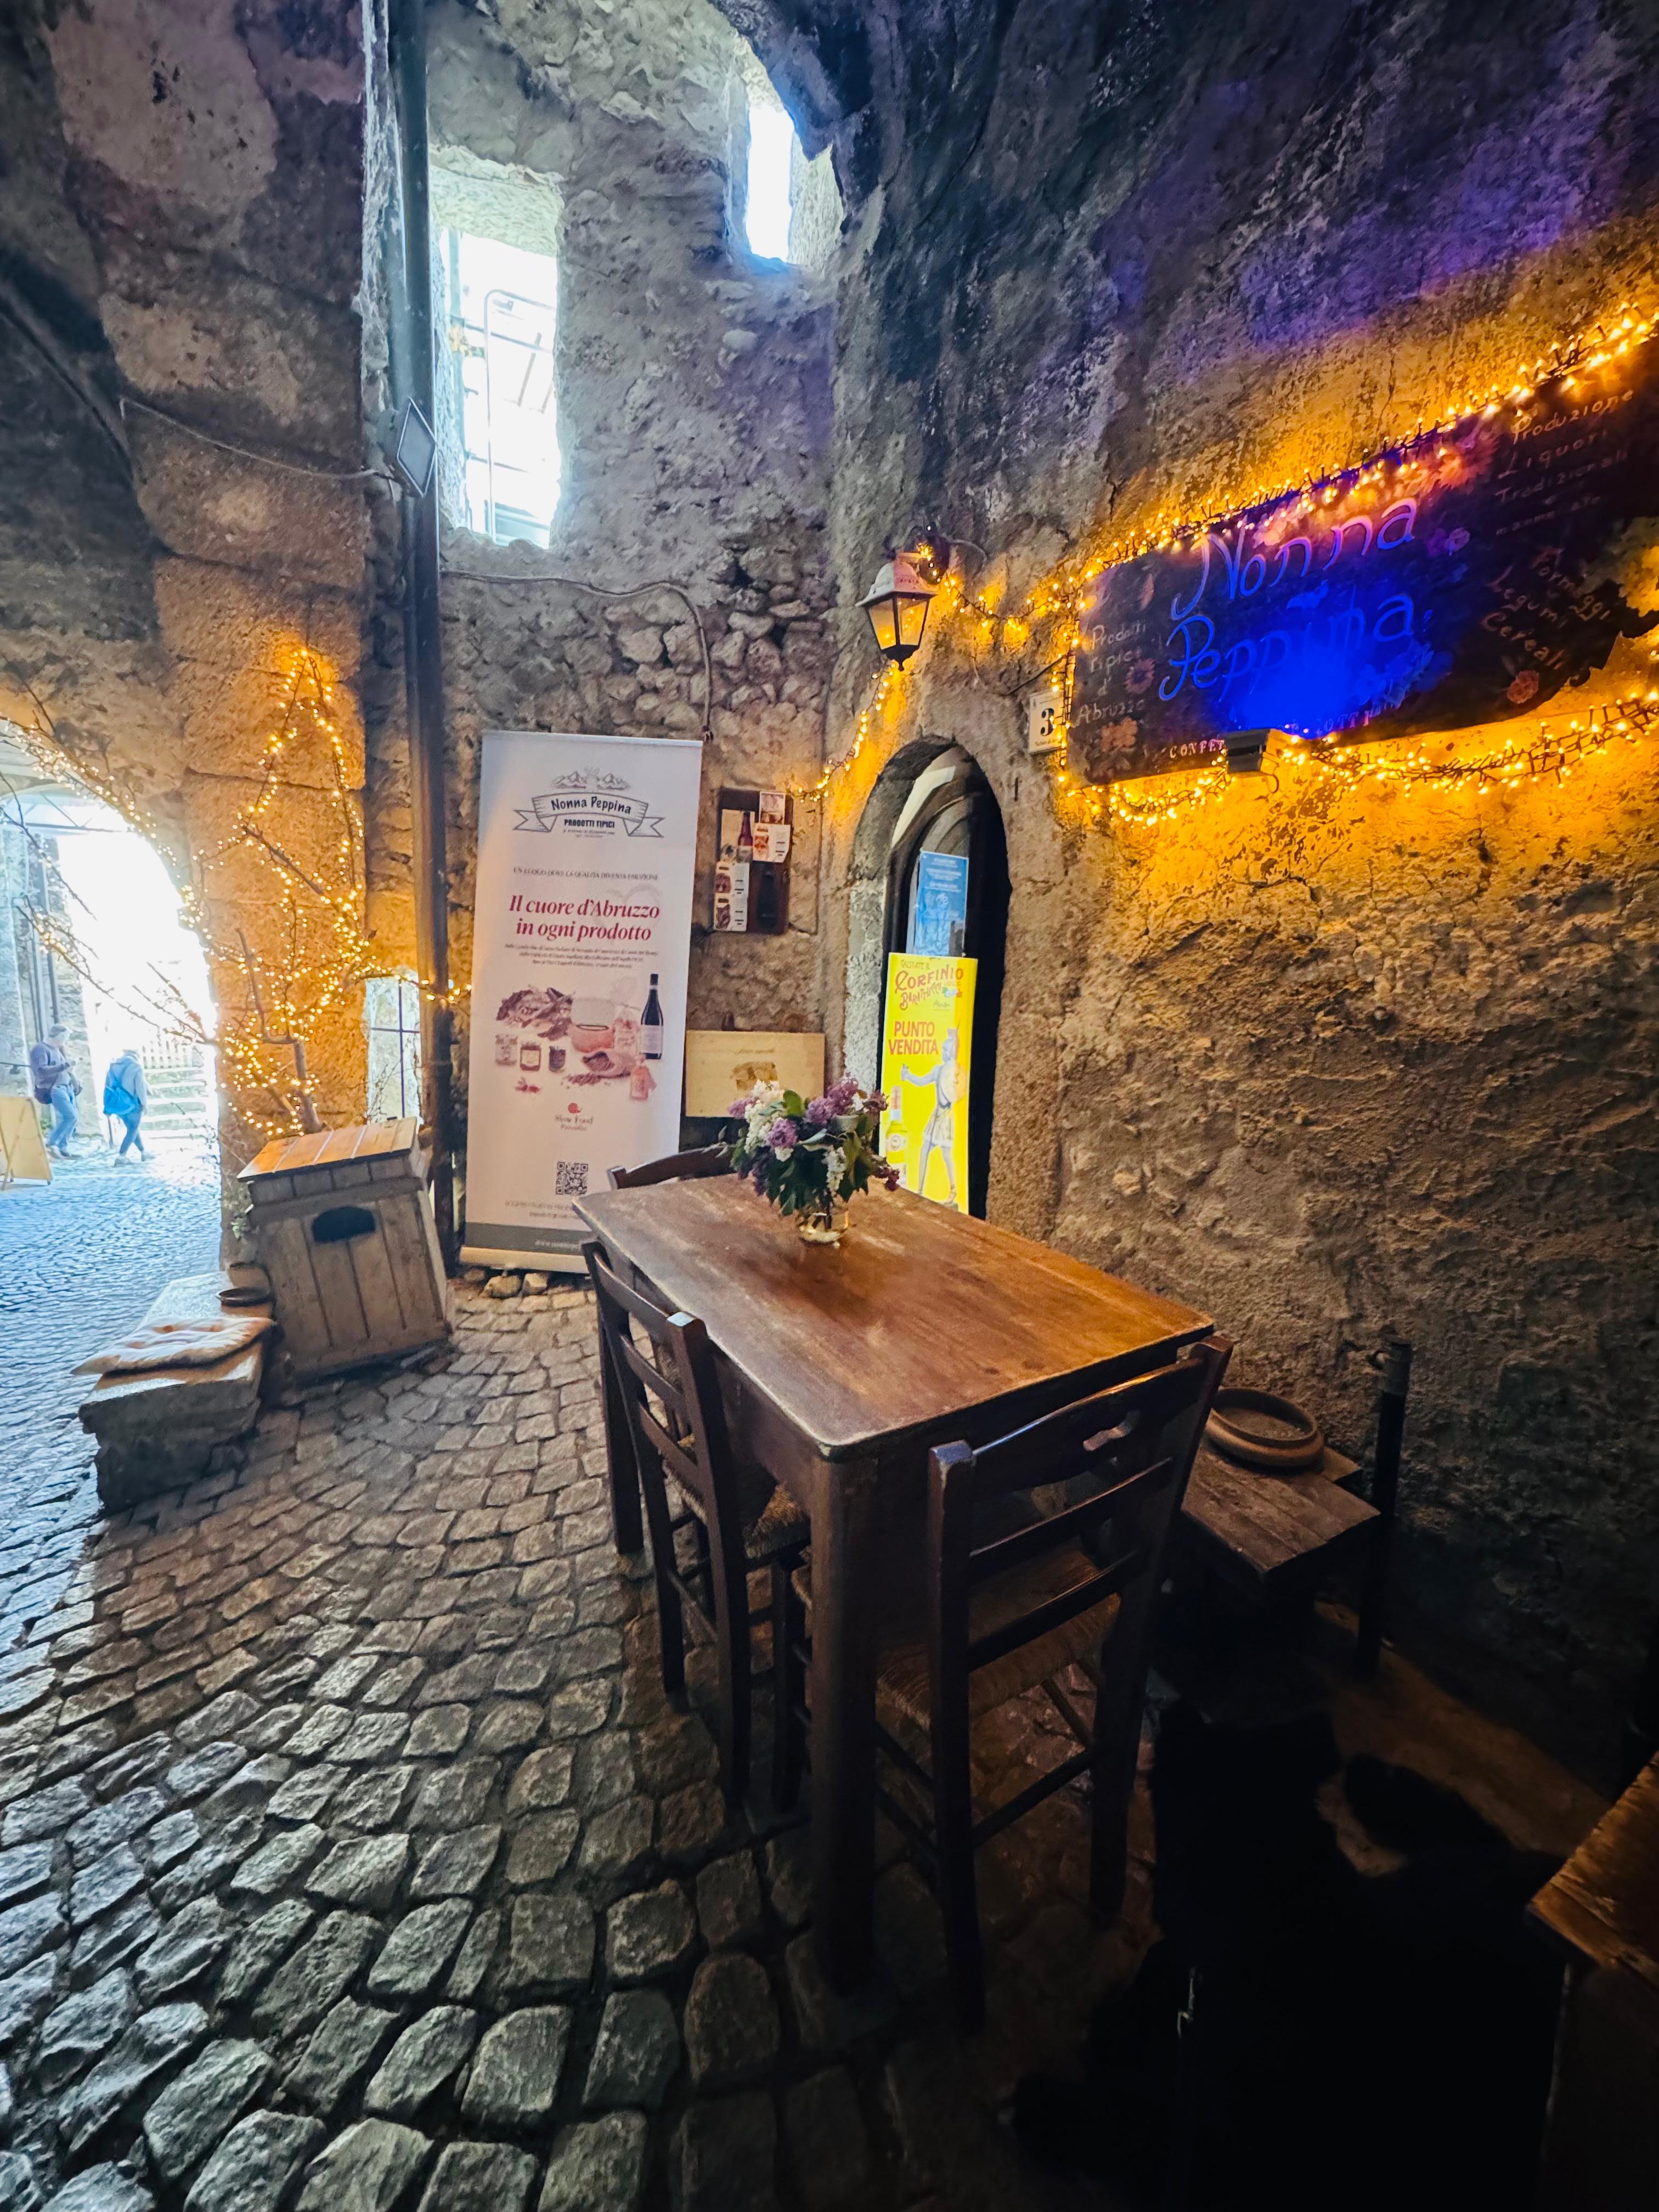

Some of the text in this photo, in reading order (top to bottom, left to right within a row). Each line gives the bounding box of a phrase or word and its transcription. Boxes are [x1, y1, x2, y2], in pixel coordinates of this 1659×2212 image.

[1510, 390, 1633, 445] Produzione
[1498, 428, 1607, 480] Liquori
[1171, 497, 1417, 620] Nonna
[1480, 611, 1565, 670] Cereali
[1040, 707, 1055, 737] 3
[1074, 698, 1146, 728] Abruzzo
[551, 796, 631, 815] Nonna Peppina
[563, 819, 616, 829] PRODOTTI TIPICI
[509, 895, 661, 919] Il cuore d'Abruzzo
[516, 918, 652, 943] in ogni prodotto
[900, 960, 924, 970] GUSTATE
[894, 964, 964, 994] CORFINIO
[894, 1020, 935, 1037] PUNTO
[888, 1039, 939, 1056] VENDITA
